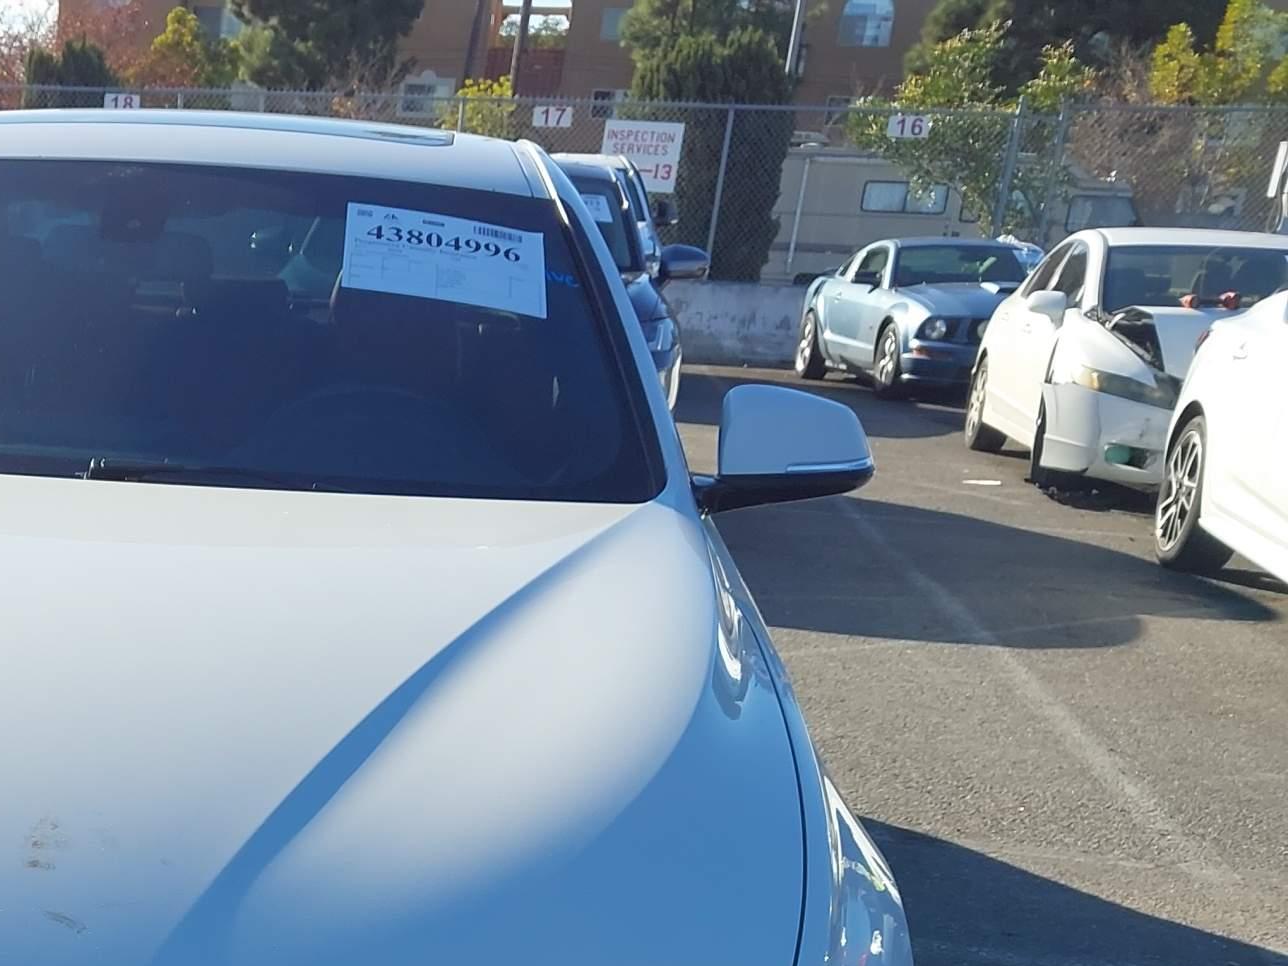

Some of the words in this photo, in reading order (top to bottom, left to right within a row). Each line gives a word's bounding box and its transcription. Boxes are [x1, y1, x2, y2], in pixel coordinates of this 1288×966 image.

[111, 95, 134, 109] 18
[541, 107, 567, 126] 17
[607, 127, 676, 143] INSPECTION
[896, 117, 923, 136] 16
[613, 142, 670, 156] SERVICES
[367, 225, 521, 263] 43804996
